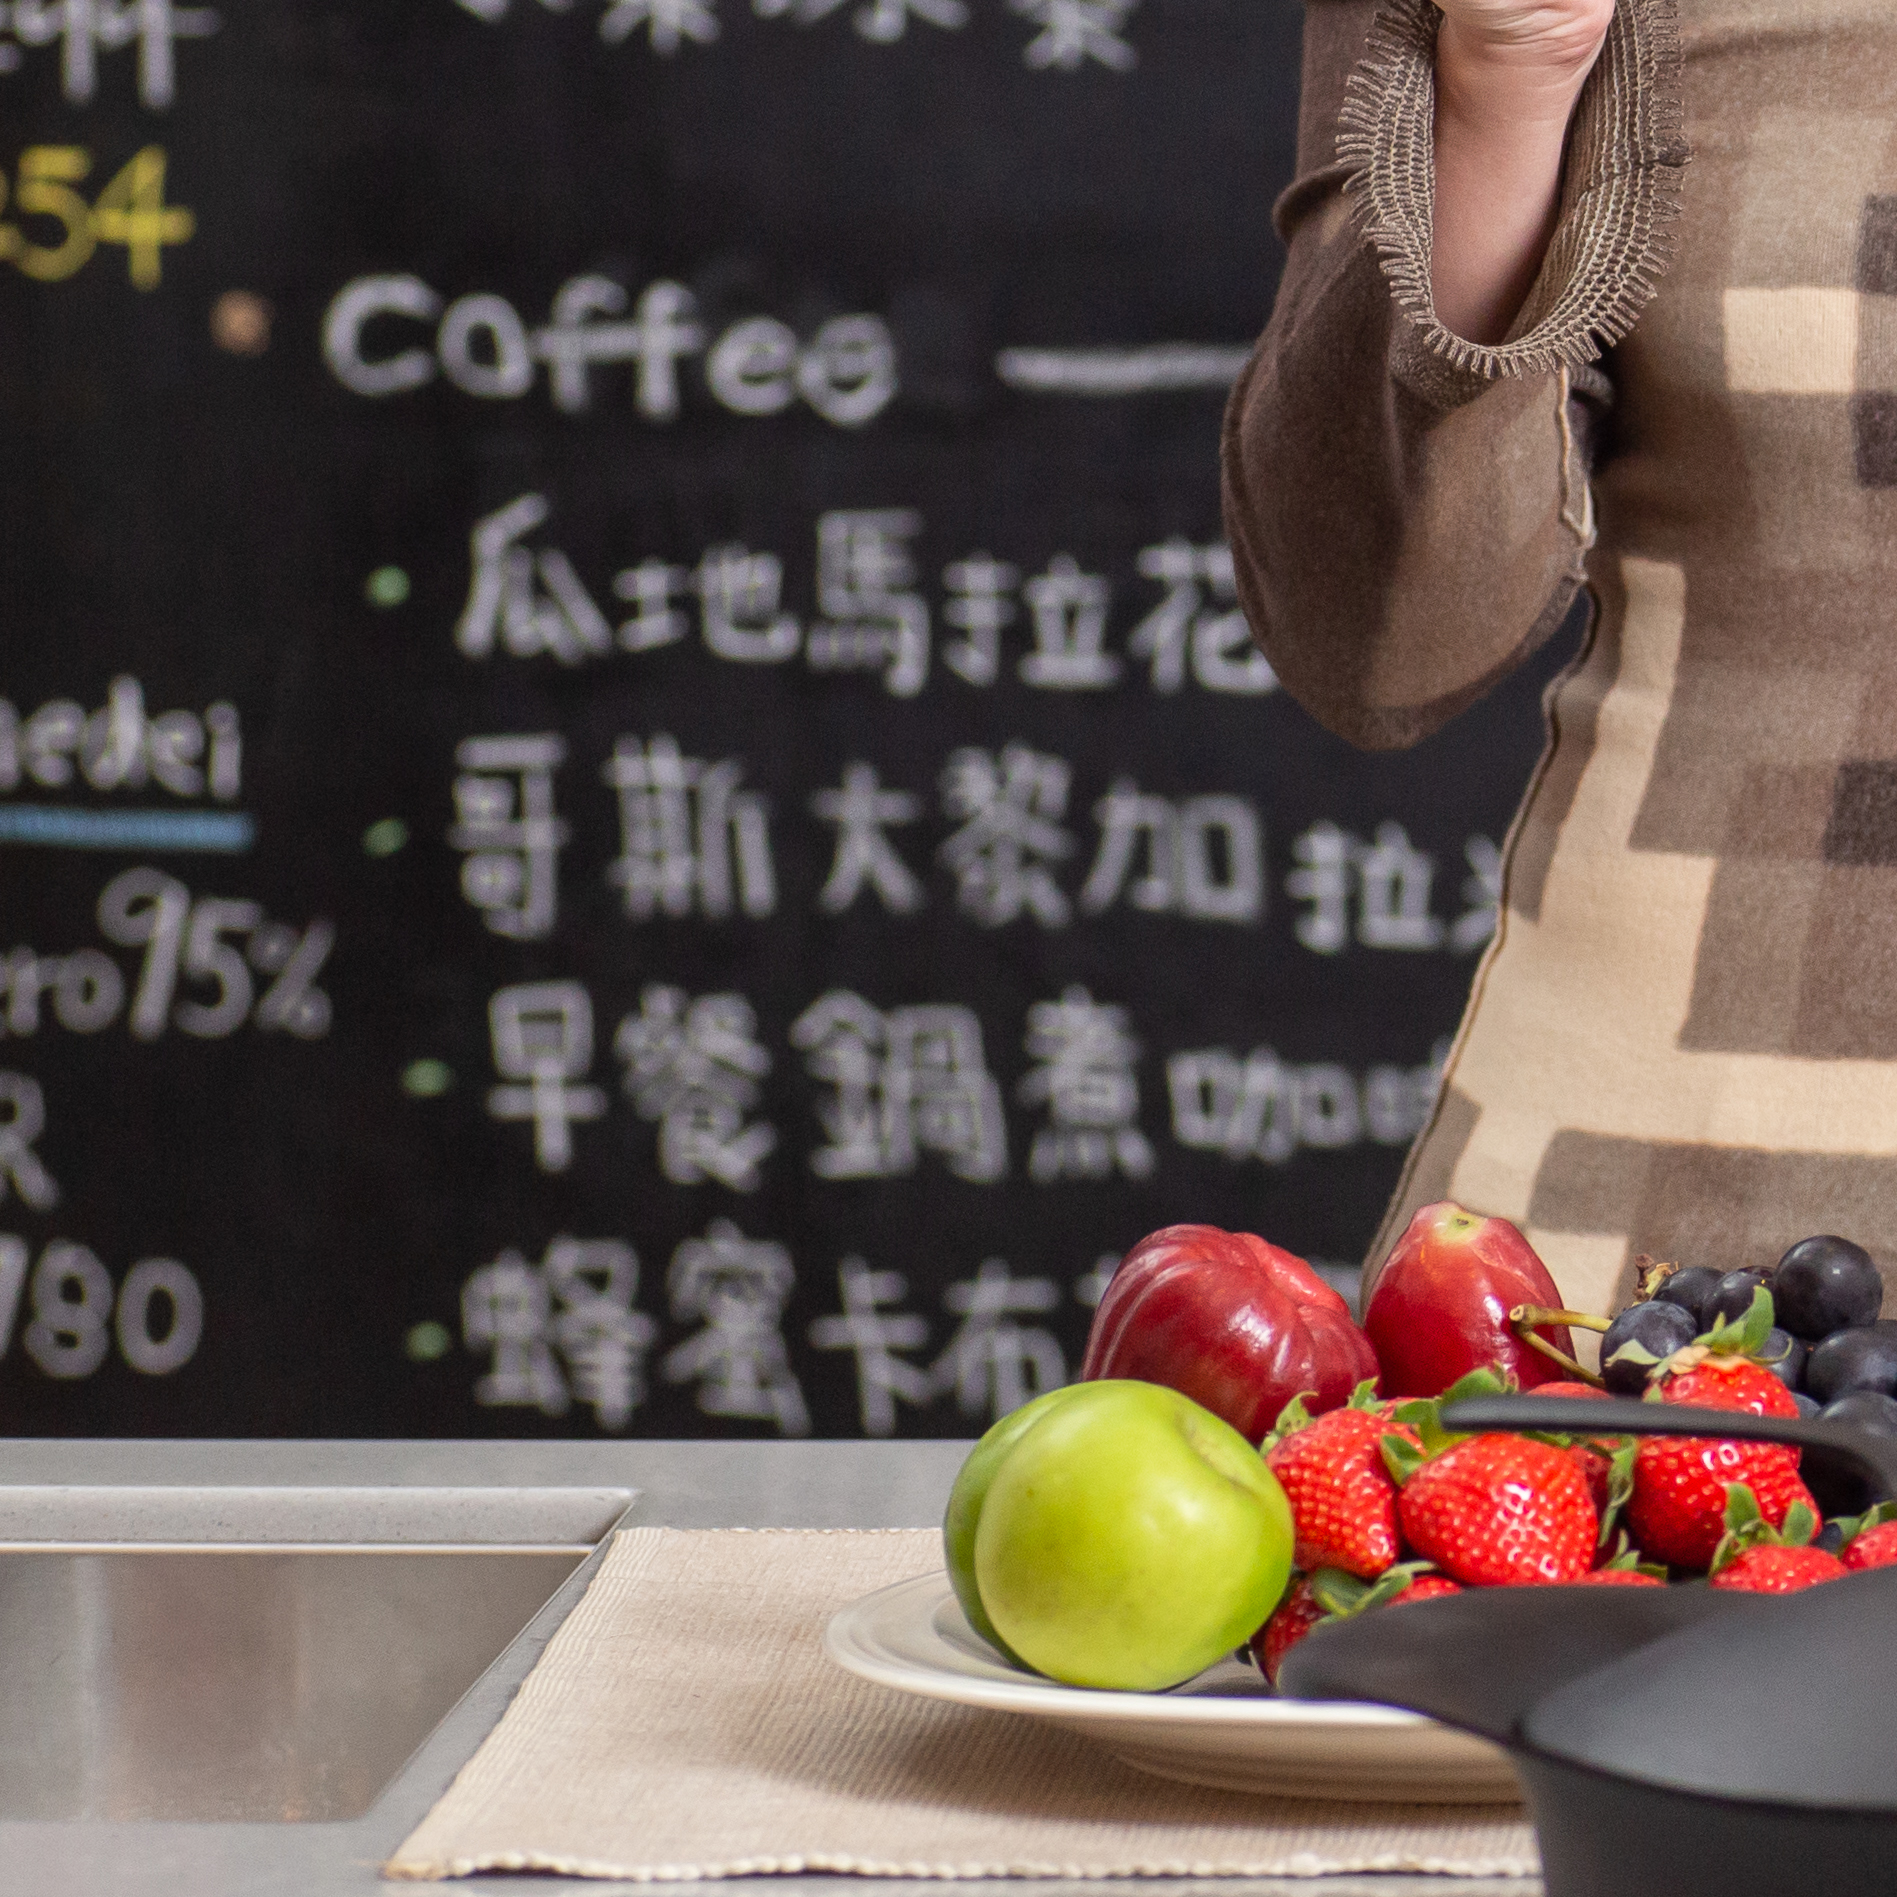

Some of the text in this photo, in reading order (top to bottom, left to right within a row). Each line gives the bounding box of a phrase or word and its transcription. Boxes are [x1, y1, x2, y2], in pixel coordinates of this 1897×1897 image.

[319, 271, 902, 424] Coffee
[458, 1221, 1115, 1436] 蜂蜜卡布
